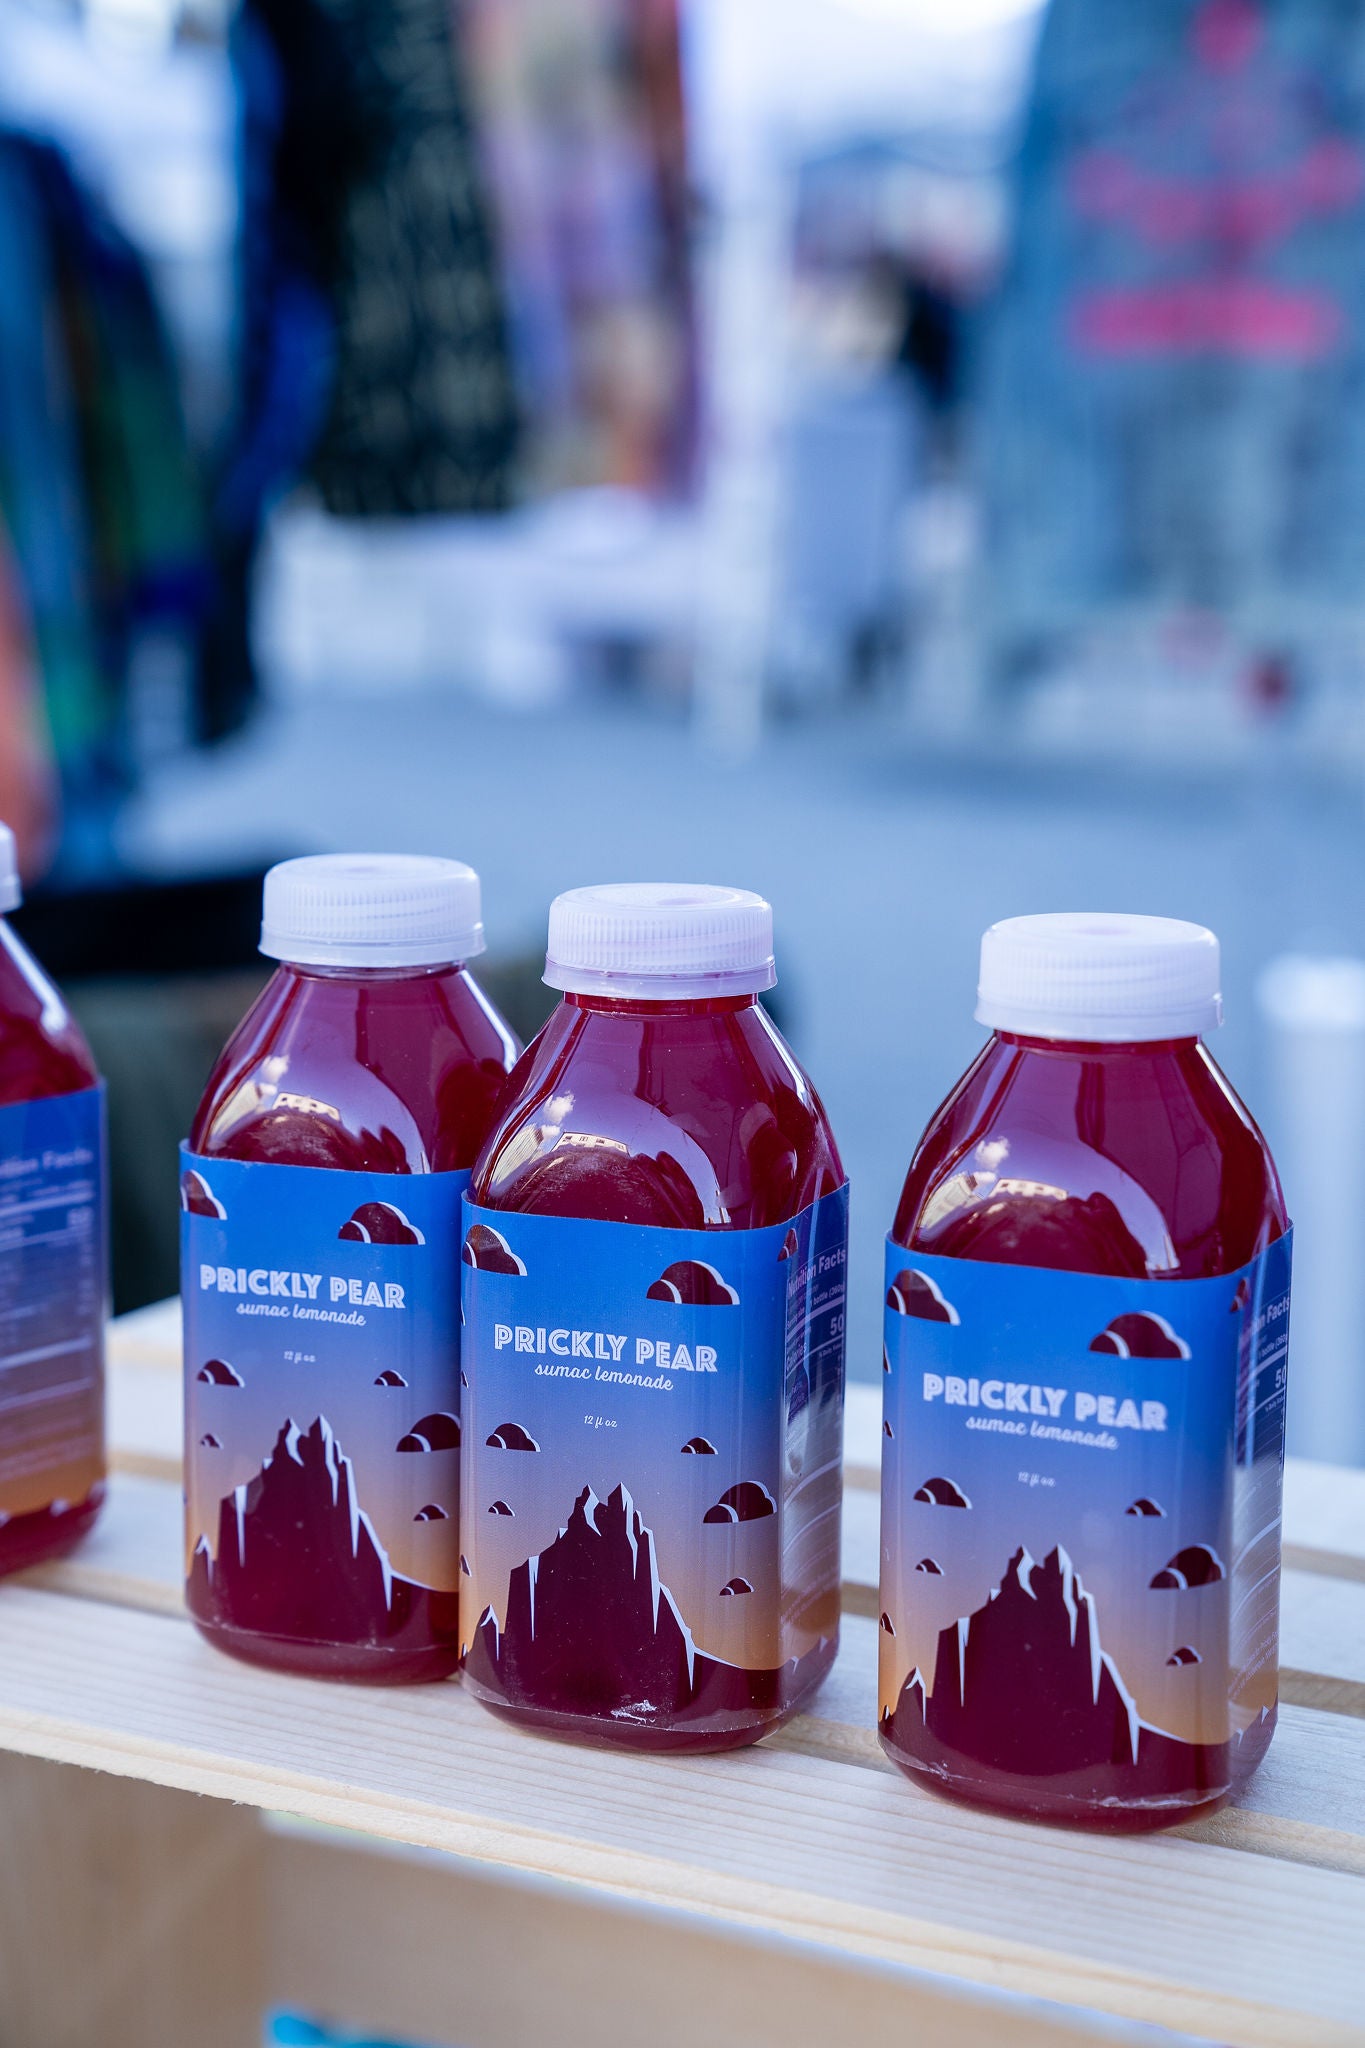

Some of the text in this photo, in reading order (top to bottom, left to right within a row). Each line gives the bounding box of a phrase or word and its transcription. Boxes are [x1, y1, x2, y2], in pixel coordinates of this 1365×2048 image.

[818, 1248, 846, 1274] Facts
[200, 1264, 406, 1309] PRICKLY PEAR
[236, 1302, 366, 1326] sumac lemonade
[830, 1315, 844, 1336] 50
[494, 1323, 718, 1372] PRICKLY PEAR
[534, 1364, 674, 1391] sumac lemonade
[923, 1372, 1167, 1431] PRICKLY PEAR
[584, 1415, 617, 1429] 12 fl oz
[965, 1415, 1119, 1450] sumac lemonade
